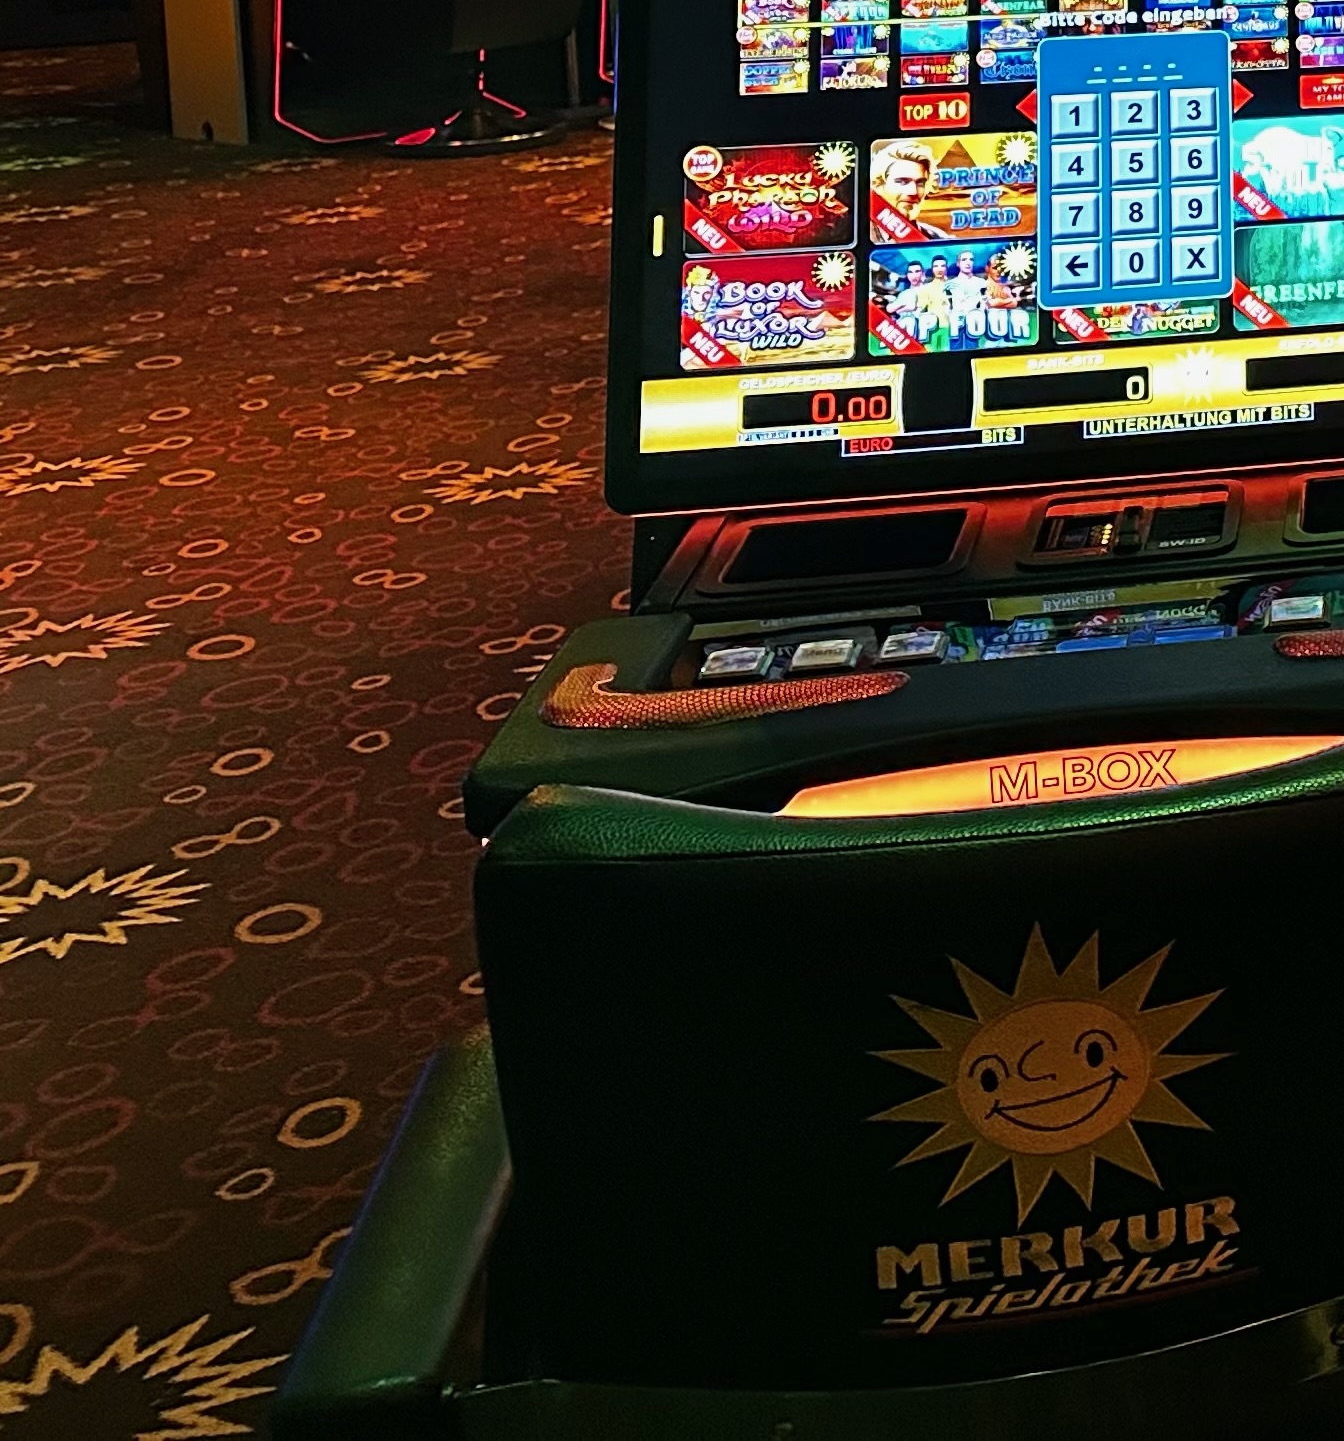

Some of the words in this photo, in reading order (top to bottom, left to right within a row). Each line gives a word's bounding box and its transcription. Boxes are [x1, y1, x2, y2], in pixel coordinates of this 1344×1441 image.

[1092, 9, 1138, 26] Code
[1141, 6, 1228, 26] eingeben
[904, 104, 933, 120] TOP
[936, 100, 968, 120] 10
[1068, 106, 1081, 126] 1
[1127, 103, 1143, 124] 2
[1186, 100, 1202, 121] 3
[1067, 156, 1084, 176] 4
[1128, 152, 1144, 173] 5
[1187, 149, 1203, 170] 6
[938, 164, 1035, 188] PRINCE
[970, 187, 1003, 207] OF
[1237, 186, 1272, 216] NEU
[1068, 206, 1084, 226] 7
[1128, 202, 1144, 222] 8
[1187, 198, 1203, 219] 9
[876, 208, 911, 239] NEU
[950, 208, 1021, 231] DEAD
[691, 218, 727, 249] NEU
[1128, 252, 1144, 273] 0
[1186, 248, 1206, 269] X
[1239, 294, 1274, 325] NEU
[949, 309, 1031, 341] FOUR
[1060, 309, 1094, 337] NEU
[1142, 315, 1216, 332] NUGGET
[875, 319, 911, 352] NEU
[689, 332, 725, 363] NEU
[1126, 375, 1145, 399] 0
[812, 392, 888, 423] 0.00
[1088, 410, 1232, 434] UNTERHALTUNG
[1236, 407, 1267, 423] MIT
[1270, 403, 1311, 420] BITS
[850, 437, 893, 453] EURO
[981, 427, 1016, 443] BITS
[989, 748, 1178, 804] M-BOX
[875, 1195, 1242, 1290] MERKUR
[881, 1246, 1240, 1335] Spielothek
